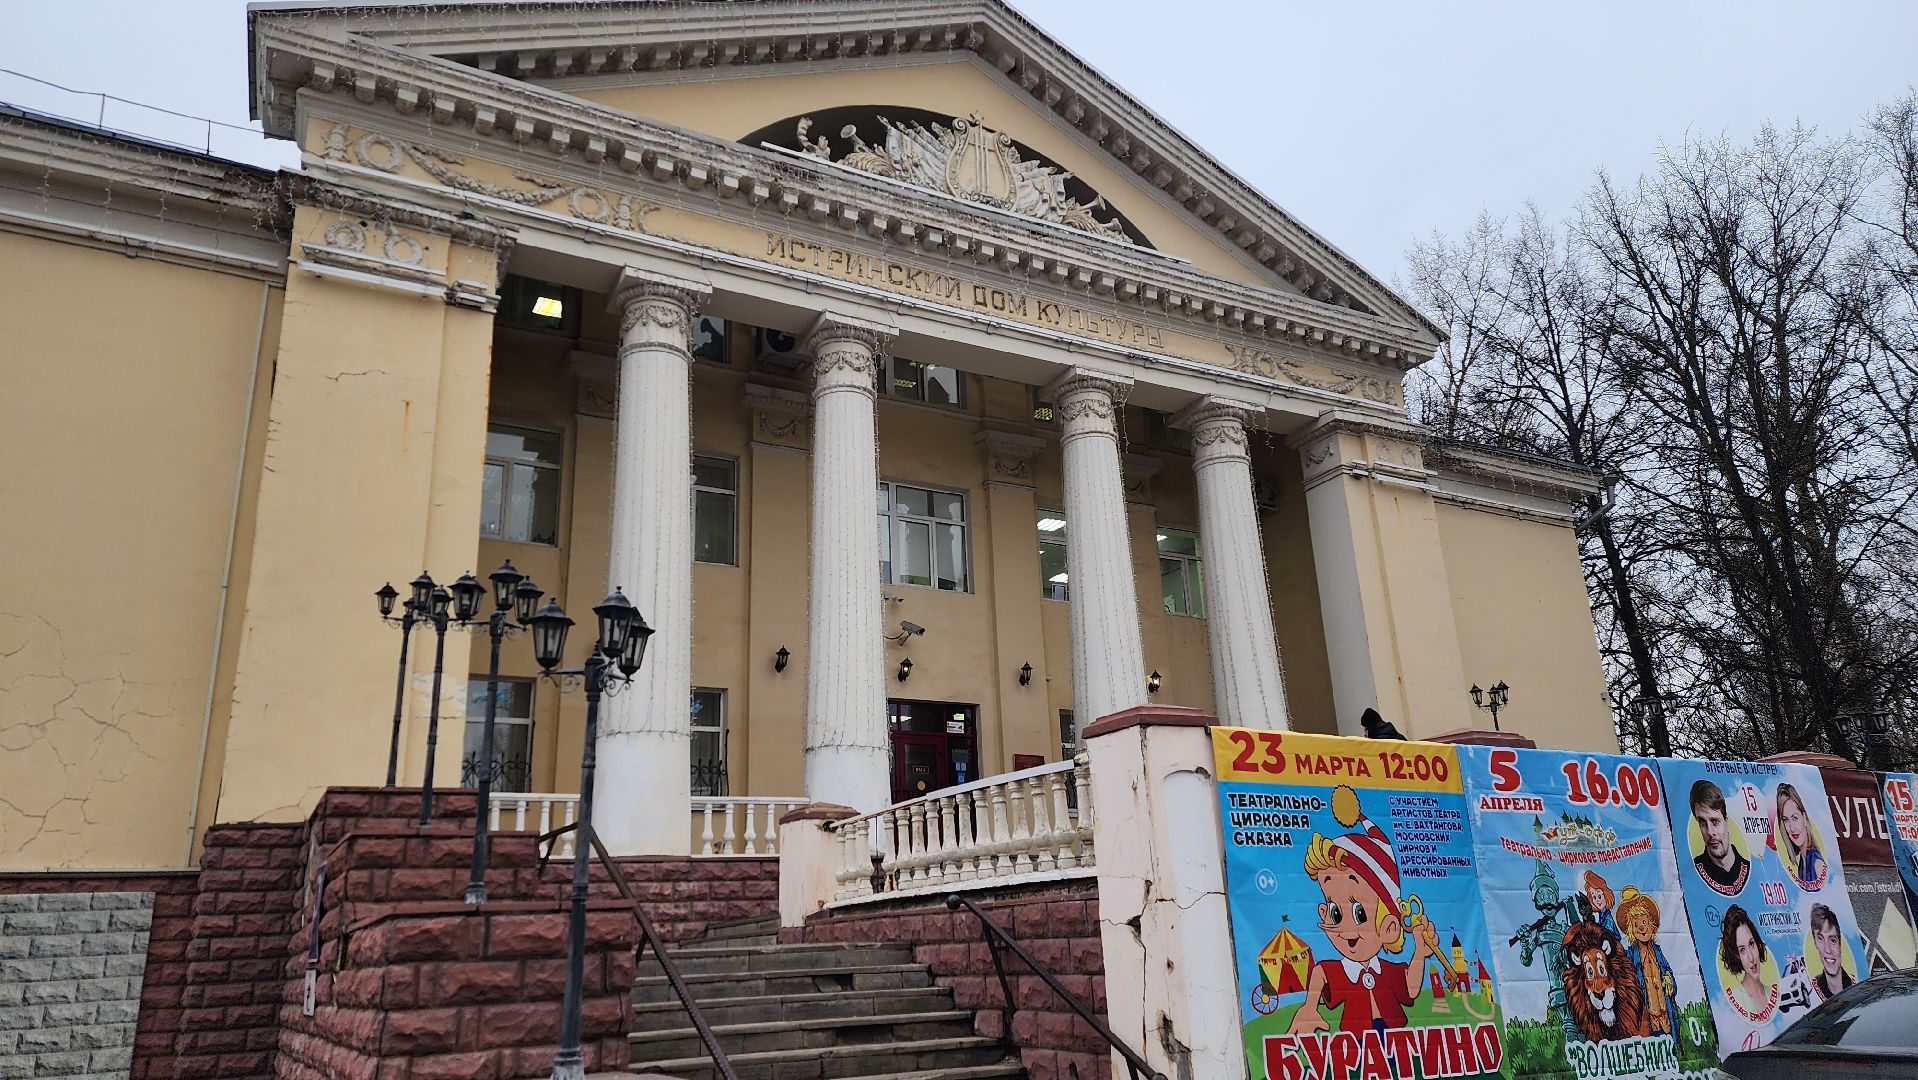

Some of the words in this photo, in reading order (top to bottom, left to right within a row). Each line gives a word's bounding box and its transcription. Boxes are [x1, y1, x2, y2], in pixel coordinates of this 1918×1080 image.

[766, 231, 961, 301] ИСТРИНСКИЙ
[972, 284, 1028, 317] ДОМ
[1037, 300, 1165, 349] КУЛЬТУРЫ
[1229, 730, 1286, 774] 23
[1295, 753, 1372, 777] МАРТА
[1378, 751, 1449, 782] 12:00
[1705, 762, 1742, 774] ВПЕРВЫЕ
[1743, 762, 1749, 774] В
[1750, 763, 1778, 775] ИСТРЕ!
[1489, 750, 1522, 792] 5
[1563, 760, 1660, 808] 16.00
[1228, 793, 1327, 811] ТЕАТРАЛЬНО-
[1389, 796, 1395, 806] С
[1396, 796, 1439, 807] УЧАСТИЕМ
[1741, 786, 1758, 812] 15
[1887, 780, 1914, 811] 15
[1480, 797, 1544, 812] АПРЕЛЯ
[1231, 813, 1310, 829] ЦИРКОВАЯ
[1391, 809, 1433, 818] АРТИСТОВ
[1434, 810, 1462, 820] ТЕАТРА
[1828, 796, 1890, 839] УЛЬ
[1743, 817, 1772, 834] АПРЕЛЯ
[1897, 825, 1918, 839] 17:0
[1233, 831, 1293, 847] СКАЗКА
[1395, 832, 1451, 842] МОСКОВСКИХ
[1397, 844, 1430, 854] ЦИРКОВ
[1431, 845, 1438, 854] И
[1499, 836, 1553, 861] театрально
[1558, 850, 1598, 867] цирковое
[1599, 836, 1652, 867] представление
[1400, 856, 1472, 867] ДРЕССИРОВАННЫХ
[1402, 868, 1448, 878] ЖИВОТНЫХ
[1258, 874, 1275, 889] 0+
[1760, 881, 1788, 905] 19:00
[1688, 1016, 1708, 1046] 0+
[1264, 1023, 1503, 1080] БУРАТИНО
